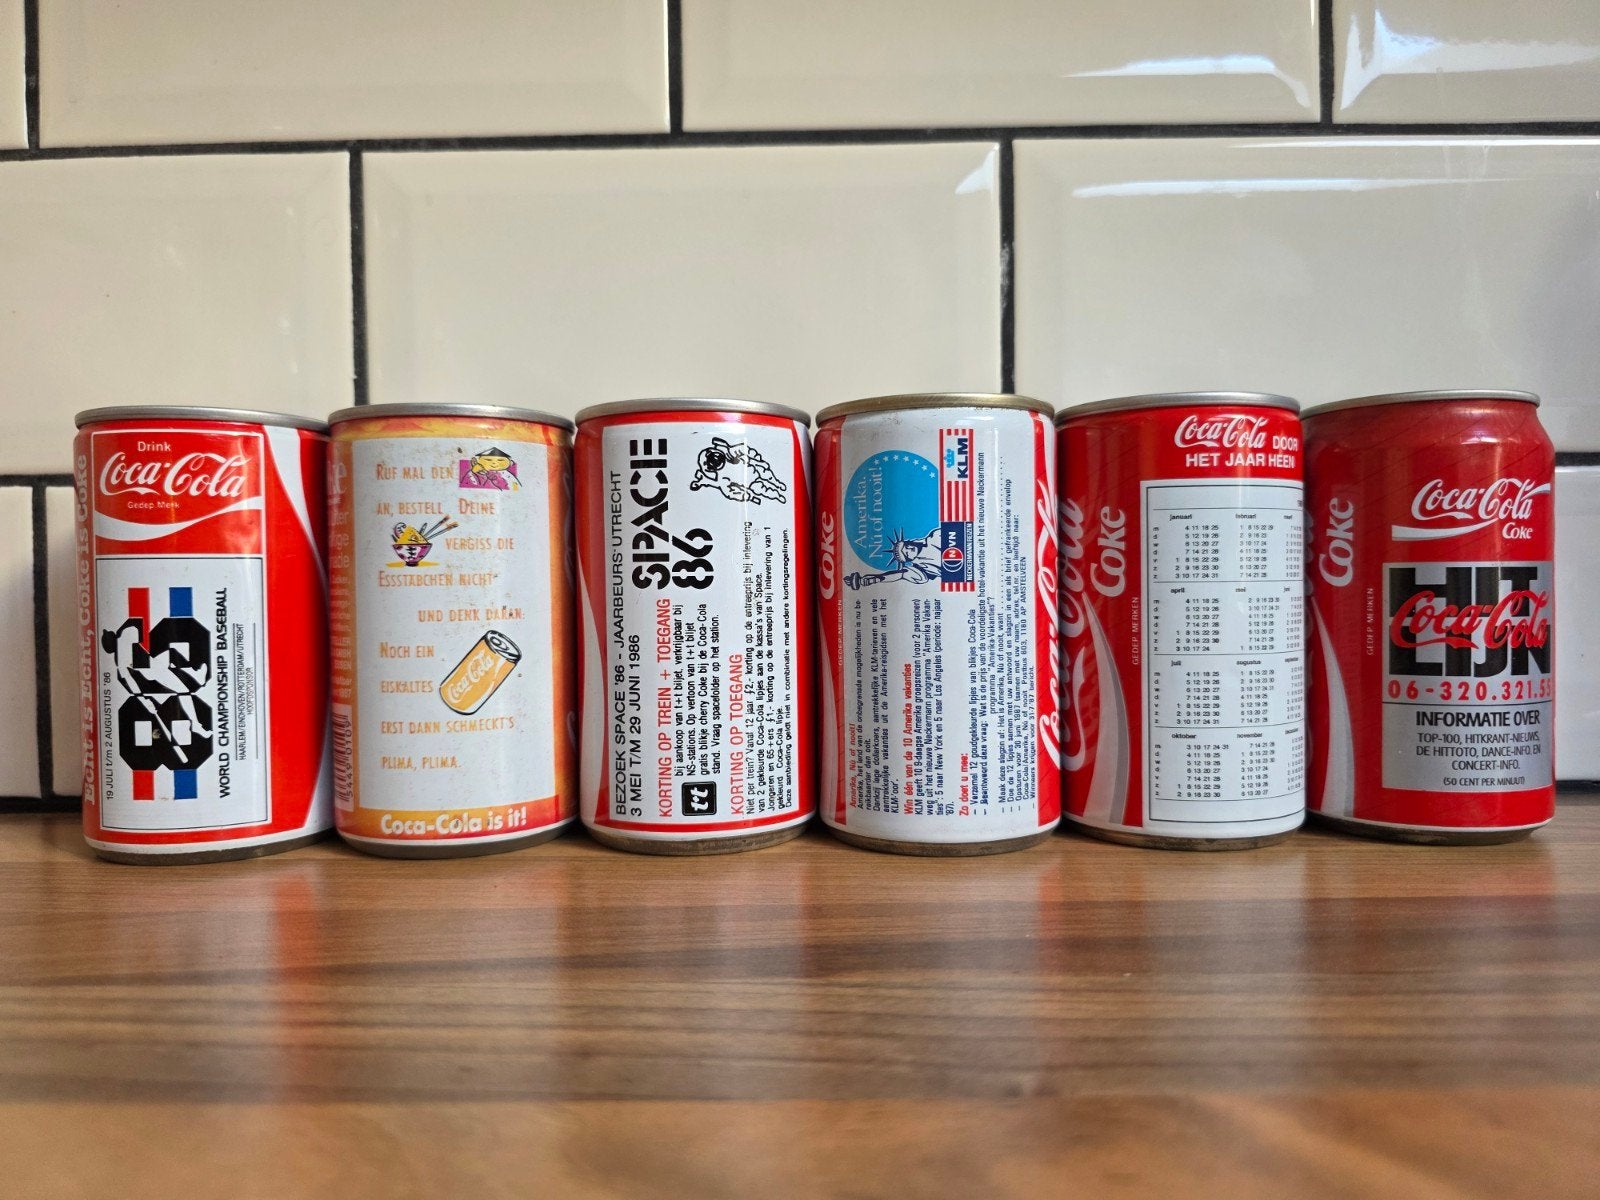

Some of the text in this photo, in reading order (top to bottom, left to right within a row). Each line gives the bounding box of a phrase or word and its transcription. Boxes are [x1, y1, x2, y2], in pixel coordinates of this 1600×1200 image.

[1174, 414, 1298, 451] Coca-Cola DOOR
[138, 442, 171, 452] Drink
[957, 438, 968, 478] KLM
[1186, 453, 1295, 468] HET JAAR HEEN
[100, 452, 250, 497] Coca-Cola
[376, 464, 454, 480] RUF MAL DEN
[77, 454, 88, 522] Coke
[868, 467, 883, 512] nooit!
[1411, 478, 1535, 520] Coca-Cola
[399, 502, 443, 514] BESTELL
[458, 498, 495, 514] DEINE
[611, 471, 622, 546] UTRECHT
[629, 438, 670, 590] SPACE
[854, 476, 866, 548] Amerika.
[869, 514, 883, 531] of
[1502, 522, 1533, 539] Coke
[78, 527, 89, 554] is
[445, 538, 514, 550] VERGISS DIE
[1090, 506, 1126, 598] Coke
[1319, 498, 1354, 587] Coke
[672, 528, 714, 589] 86
[820, 511, 834, 599] Coke
[79, 558, 90, 626] Coke
[418, 610, 443, 622] UND
[449, 609, 480, 621] DENK
[673, 604, 683, 615] bij
[1390, 590, 1549, 649] Coca-Cola
[674, 619, 684, 665] verkrijgbaar
[685, 622, 695, 641] biljet
[380, 642, 434, 658] NOCH EIN
[103, 672, 111, 686] '86
[381, 680, 433, 693] EISKALTES
[615, 665, 625, 685] '86
[902, 664, 911, 699] vakanties
[216, 588, 230, 798] WORLD CHAMPIONSHIP BASEBALL
[697, 604, 709, 775] gratis blikje cherry Coke bij de Coca-Cola
[710, 615, 722, 774] stand. Vraag spacefolder op het station.
[104, 689, 112, 739] AUGUSTUS
[615, 691, 625, 744] SPACE
[657, 599, 672, 817] KORTING OP TREIN TOEGANG
[687, 714, 696, 725] Op
[903, 703, 912, 734] Amerika
[1416, 710, 1540, 727] INFORMATIE OVER
[381, 721, 403, 734] ERST
[409, 721, 441, 734] DANN
[629, 634, 642, 817] 3 MEI T/M 29 JUNI 1986
[730, 654, 744, 815] KORTING OP TOEGANG
[1418, 733, 1462, 745] TOP-100,
[676, 730, 685, 763] aankoop
[687, 728, 696, 776] NS-stations.
[903, 738, 912, 747] 10
[903, 751, 912, 761] de
[1416, 746, 1430, 756] DE
[1433, 747, 1479, 757] HITTOTO,
[84, 738, 95, 805] Echt
[105, 750, 113, 766] t/m
[675, 765, 686, 776] bij
[904, 764, 913, 777] van
[960, 753, 968, 772] mee:
[1452, 760, 1520, 770] CONCERT-INFO.
[107, 790, 114, 800] 19
[616, 751, 626, 815] BEZOEK
[959, 785, 968, 802] doet
[1444, 777, 1457, 785] (50
[1460, 777, 1479, 786] CENT
[381, 806, 527, 835] Coca-Cola is it!
[904, 800, 913, 814] Win
[959, 806, 968, 816] Zo
